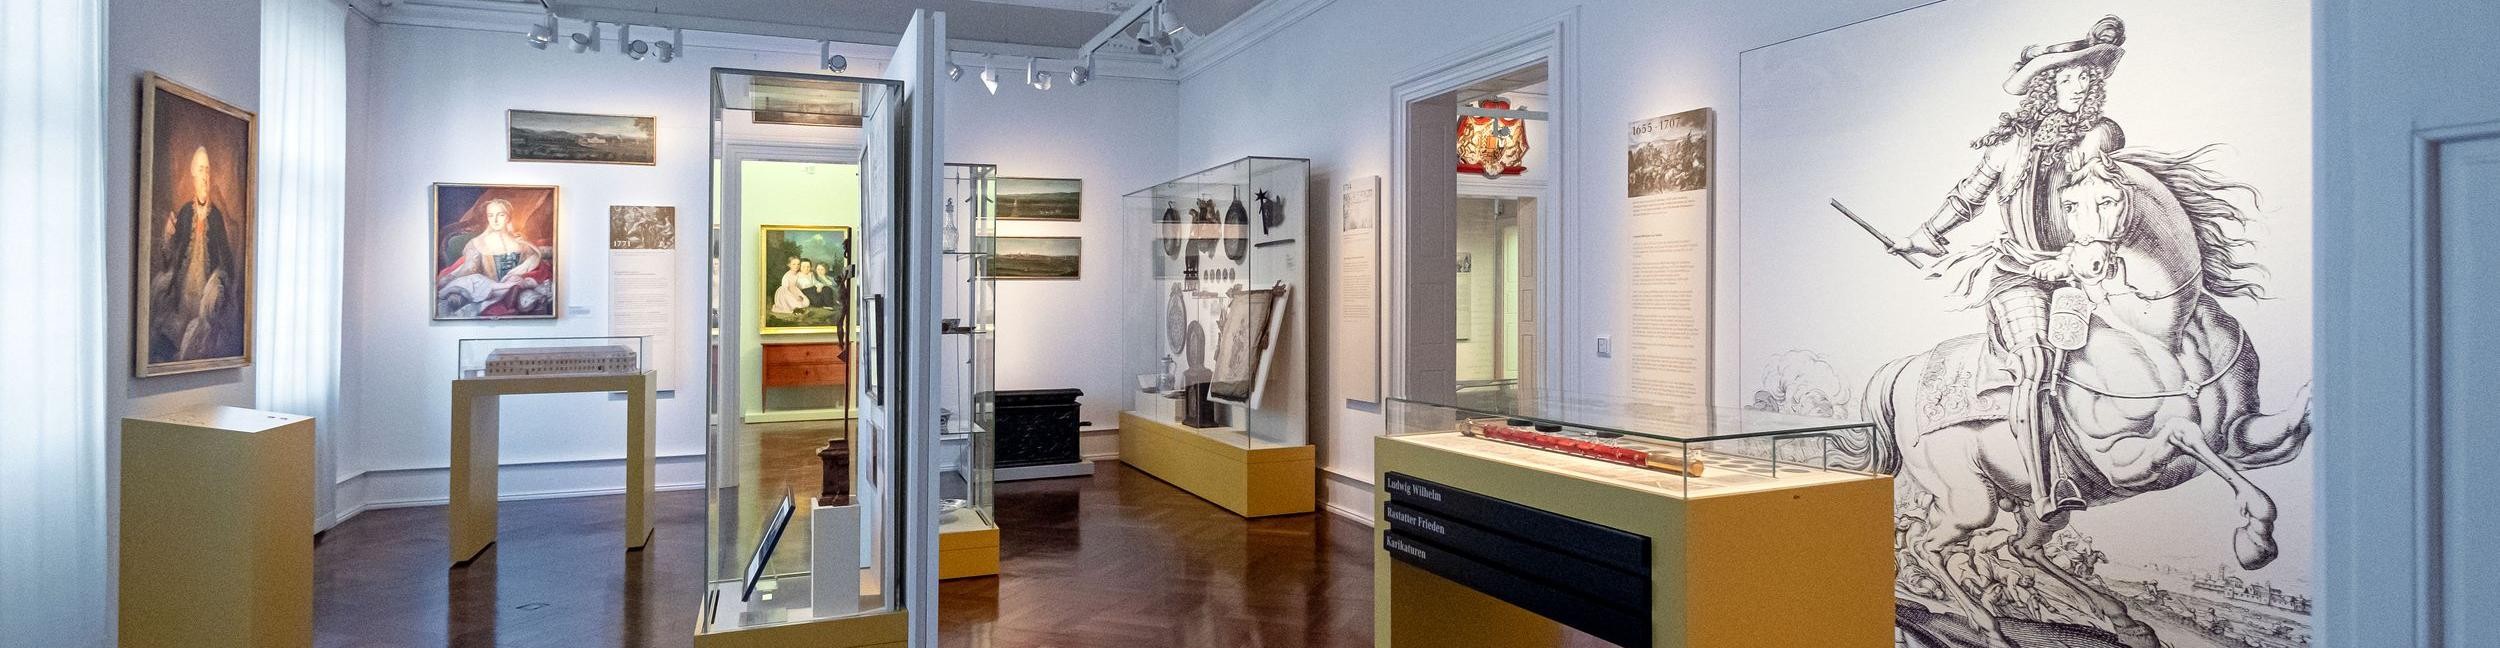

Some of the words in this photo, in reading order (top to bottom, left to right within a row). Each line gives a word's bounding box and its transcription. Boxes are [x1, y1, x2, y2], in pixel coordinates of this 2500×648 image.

[1632, 122, 1652, 135] 1655
[1660, 117, 1680, 130] 1707
[1387, 478, 1411, 495] Ludwig
[1412, 484, 1441, 501] Wilhelm
[1387, 507, 1416, 526] Rastatter
[1418, 517, 1444, 534] Frieden
[1386, 536, 1426, 559] Karikaturen
